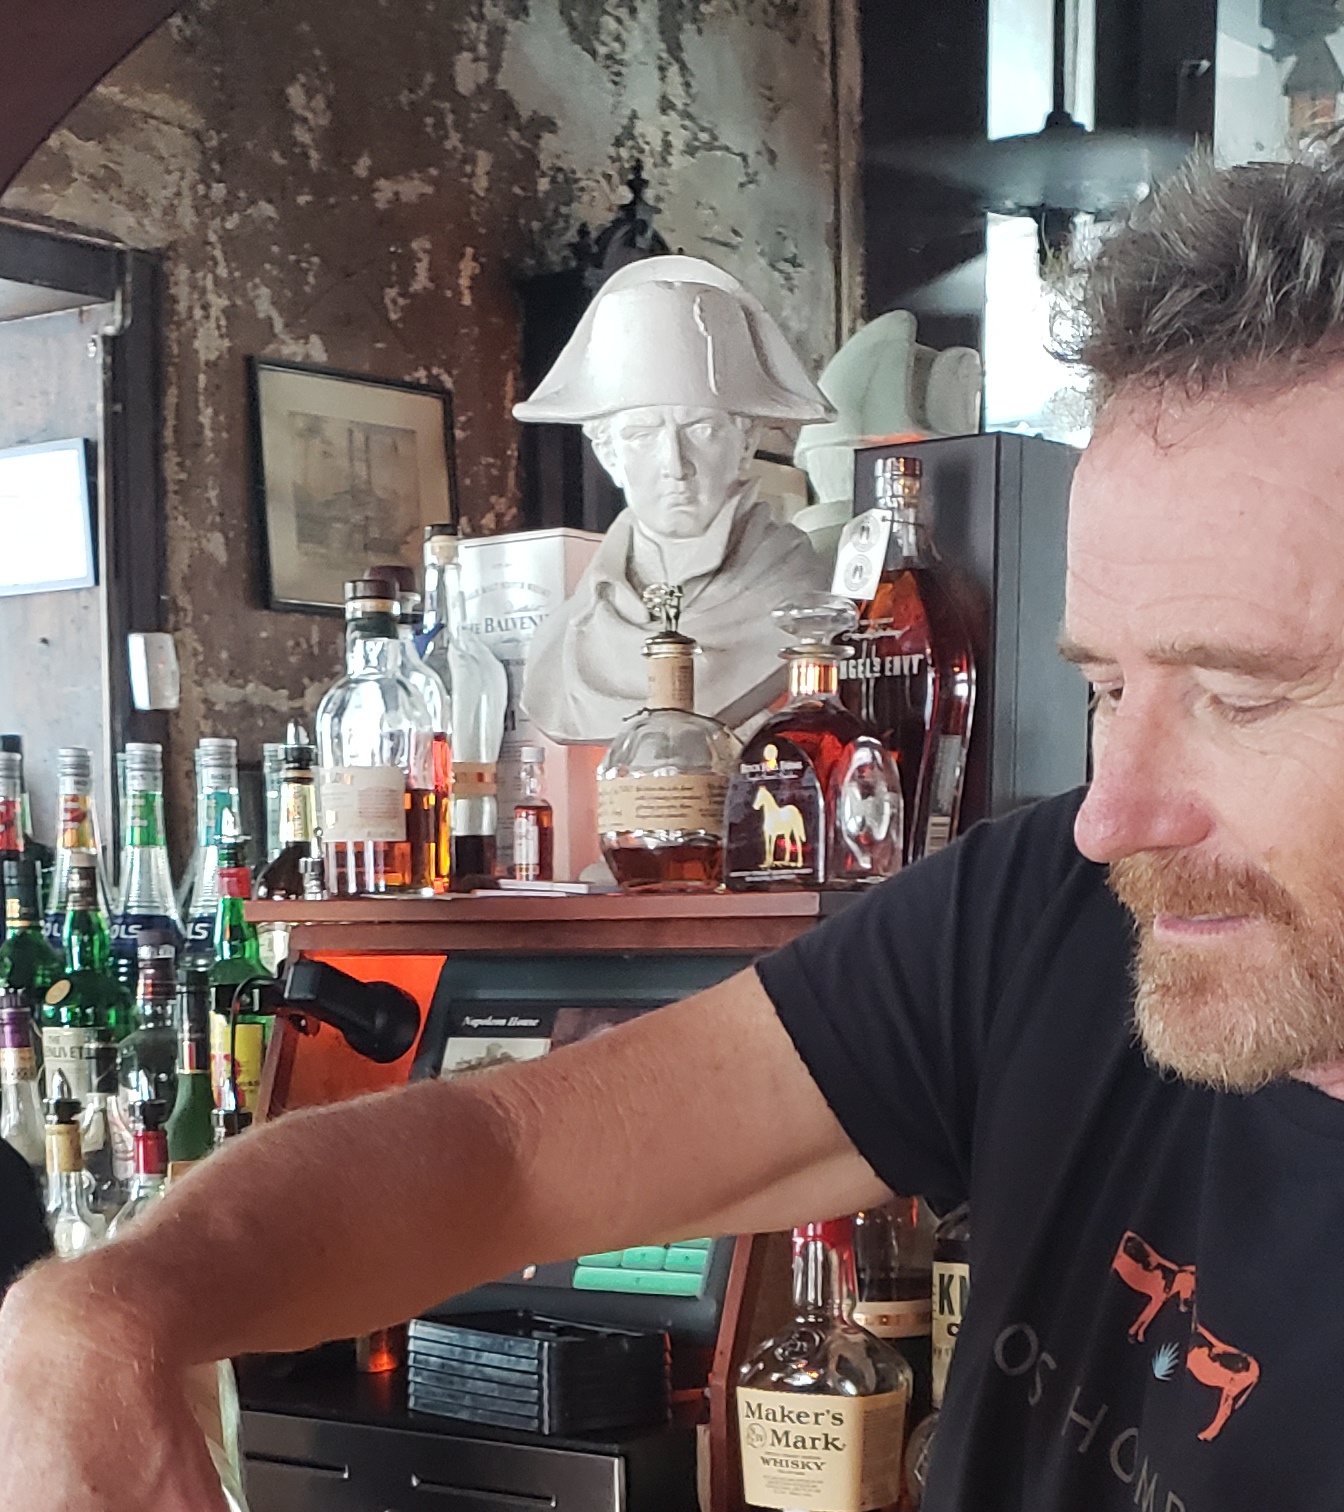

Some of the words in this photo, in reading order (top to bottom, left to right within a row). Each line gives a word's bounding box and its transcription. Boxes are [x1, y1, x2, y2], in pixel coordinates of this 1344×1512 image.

[744, 1400, 845, 1427] Maker's
[769, 1428, 845, 1452] Mark
[759, 1455, 827, 1472] WHISKY
